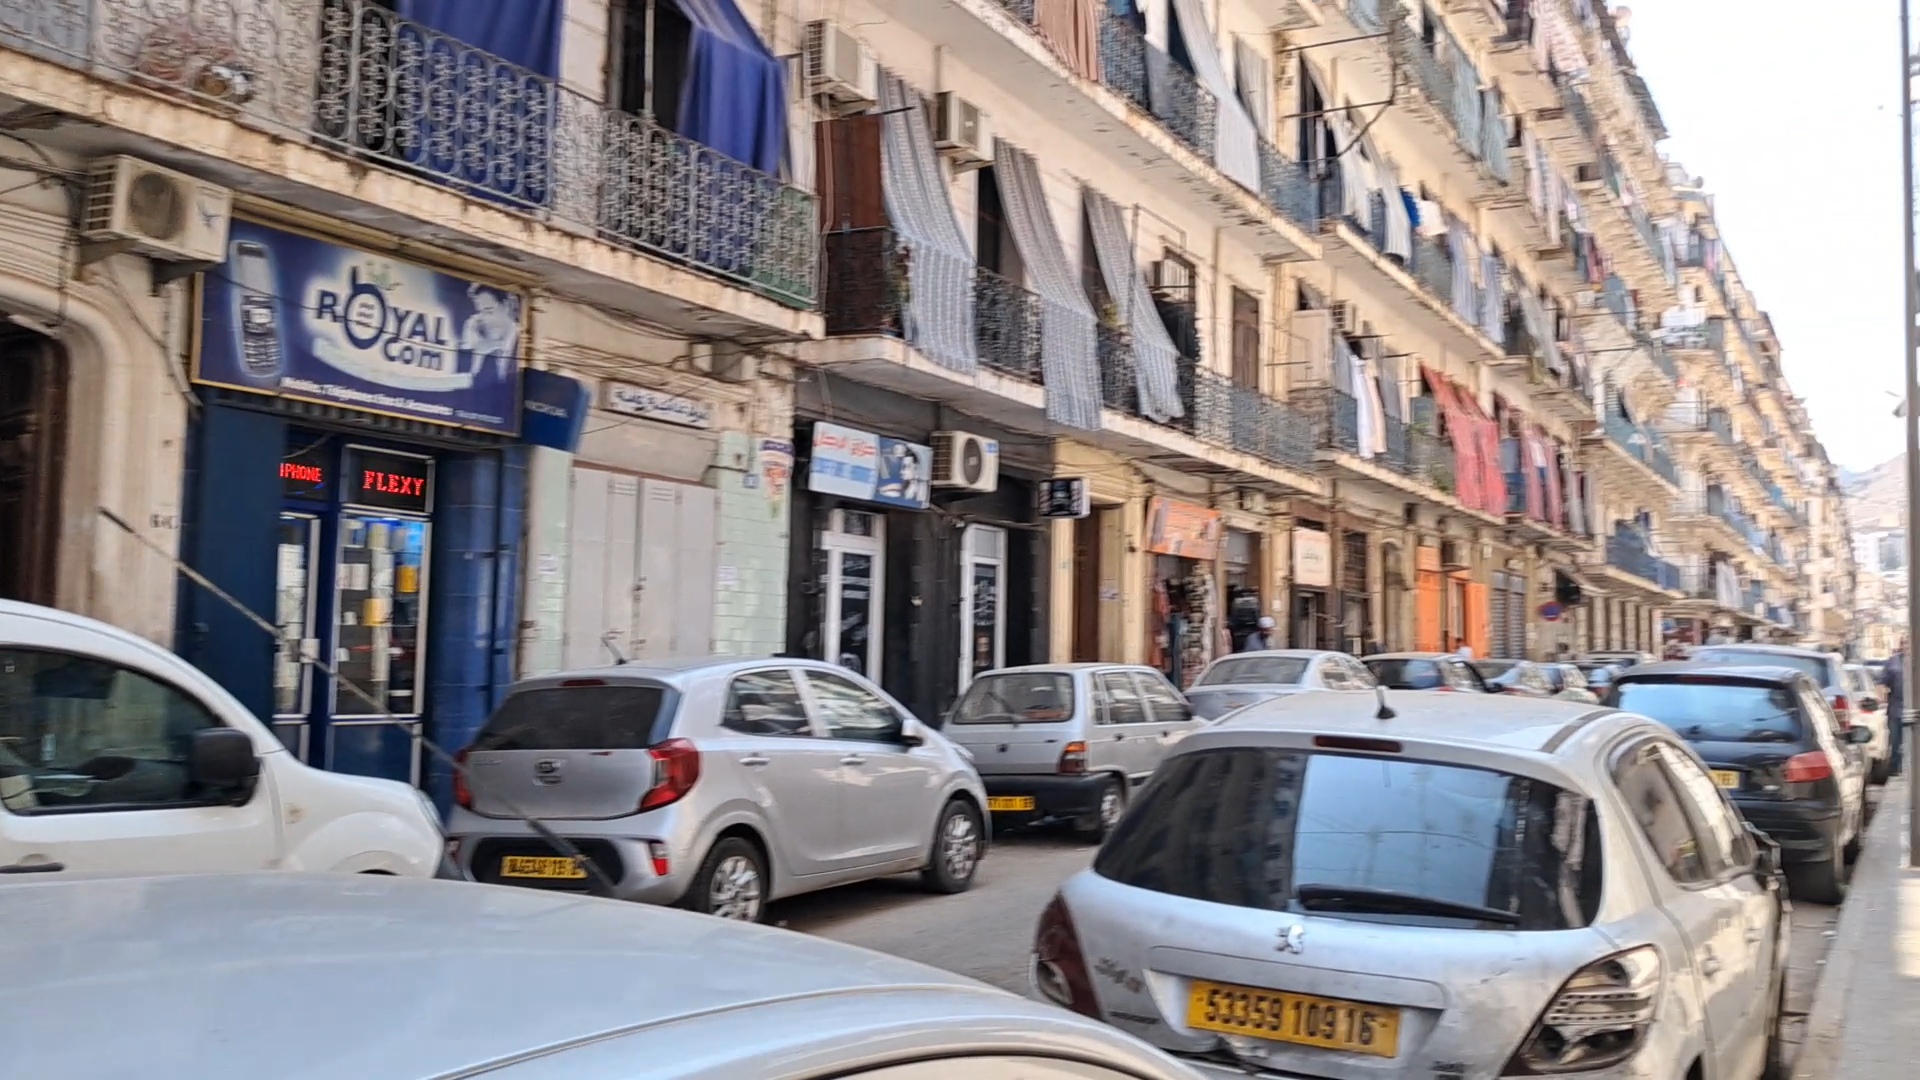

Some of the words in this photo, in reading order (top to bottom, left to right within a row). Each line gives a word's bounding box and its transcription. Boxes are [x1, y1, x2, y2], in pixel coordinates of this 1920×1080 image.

[315, 266, 445, 350] ROYAL
[383, 336, 441, 371] Com
[362, 470, 424, 497] FLEXY
[1204, 988, 1283, 1032] 53359
